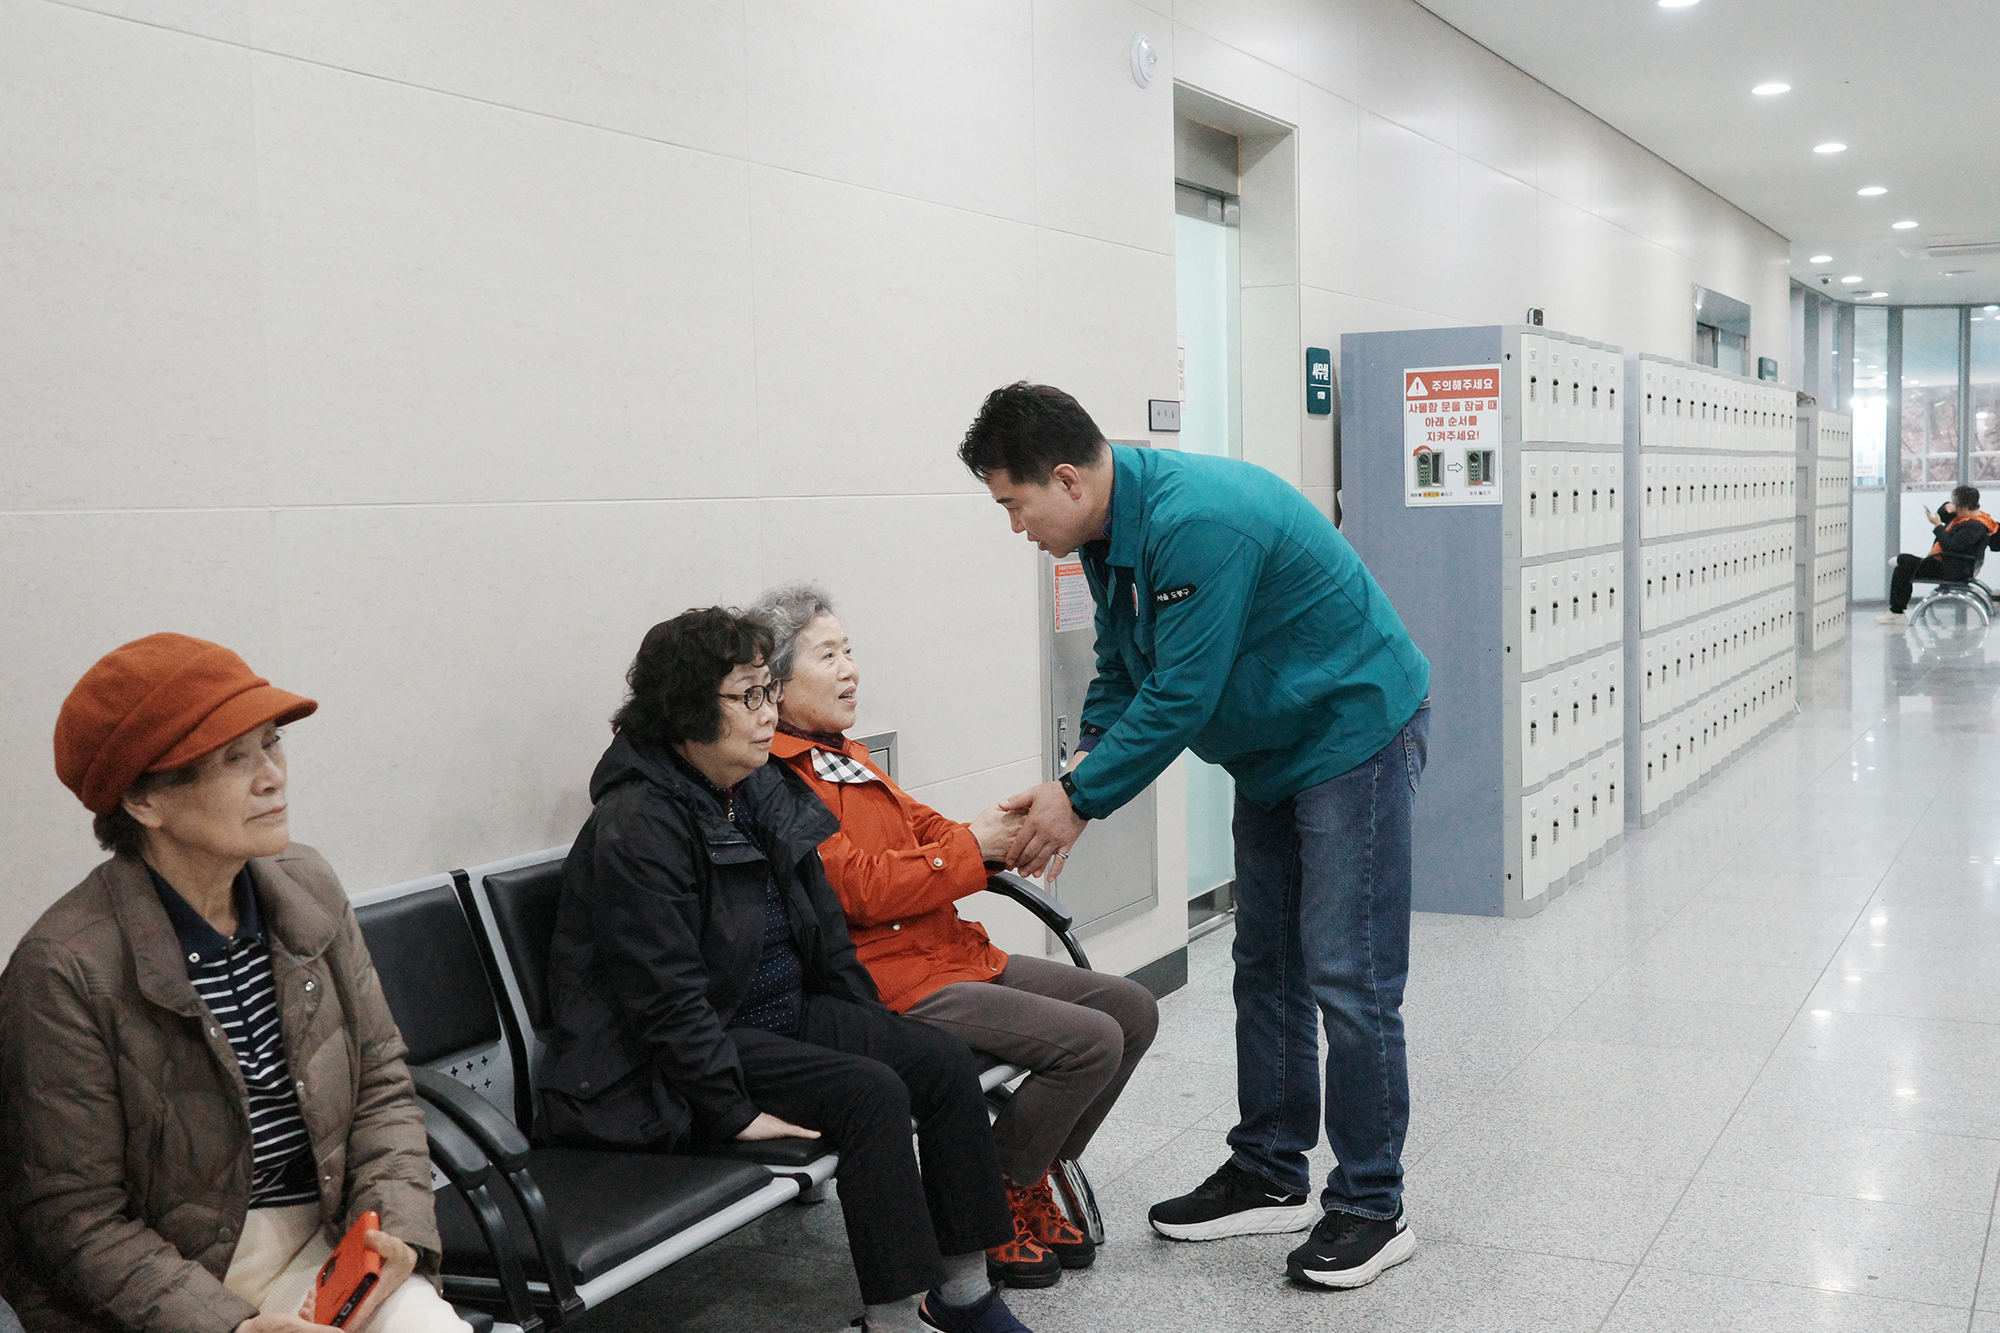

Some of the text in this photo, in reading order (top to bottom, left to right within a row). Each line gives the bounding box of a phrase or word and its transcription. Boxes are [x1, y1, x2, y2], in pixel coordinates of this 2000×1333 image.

[1432, 379, 1493, 391] 주의해주세요
[1409, 400, 1497, 413] 사물함 문을 잠글 때
[1425, 415, 1477, 427] 아래 순서를
[1426, 431, 1480, 441] 지켜주세요!
